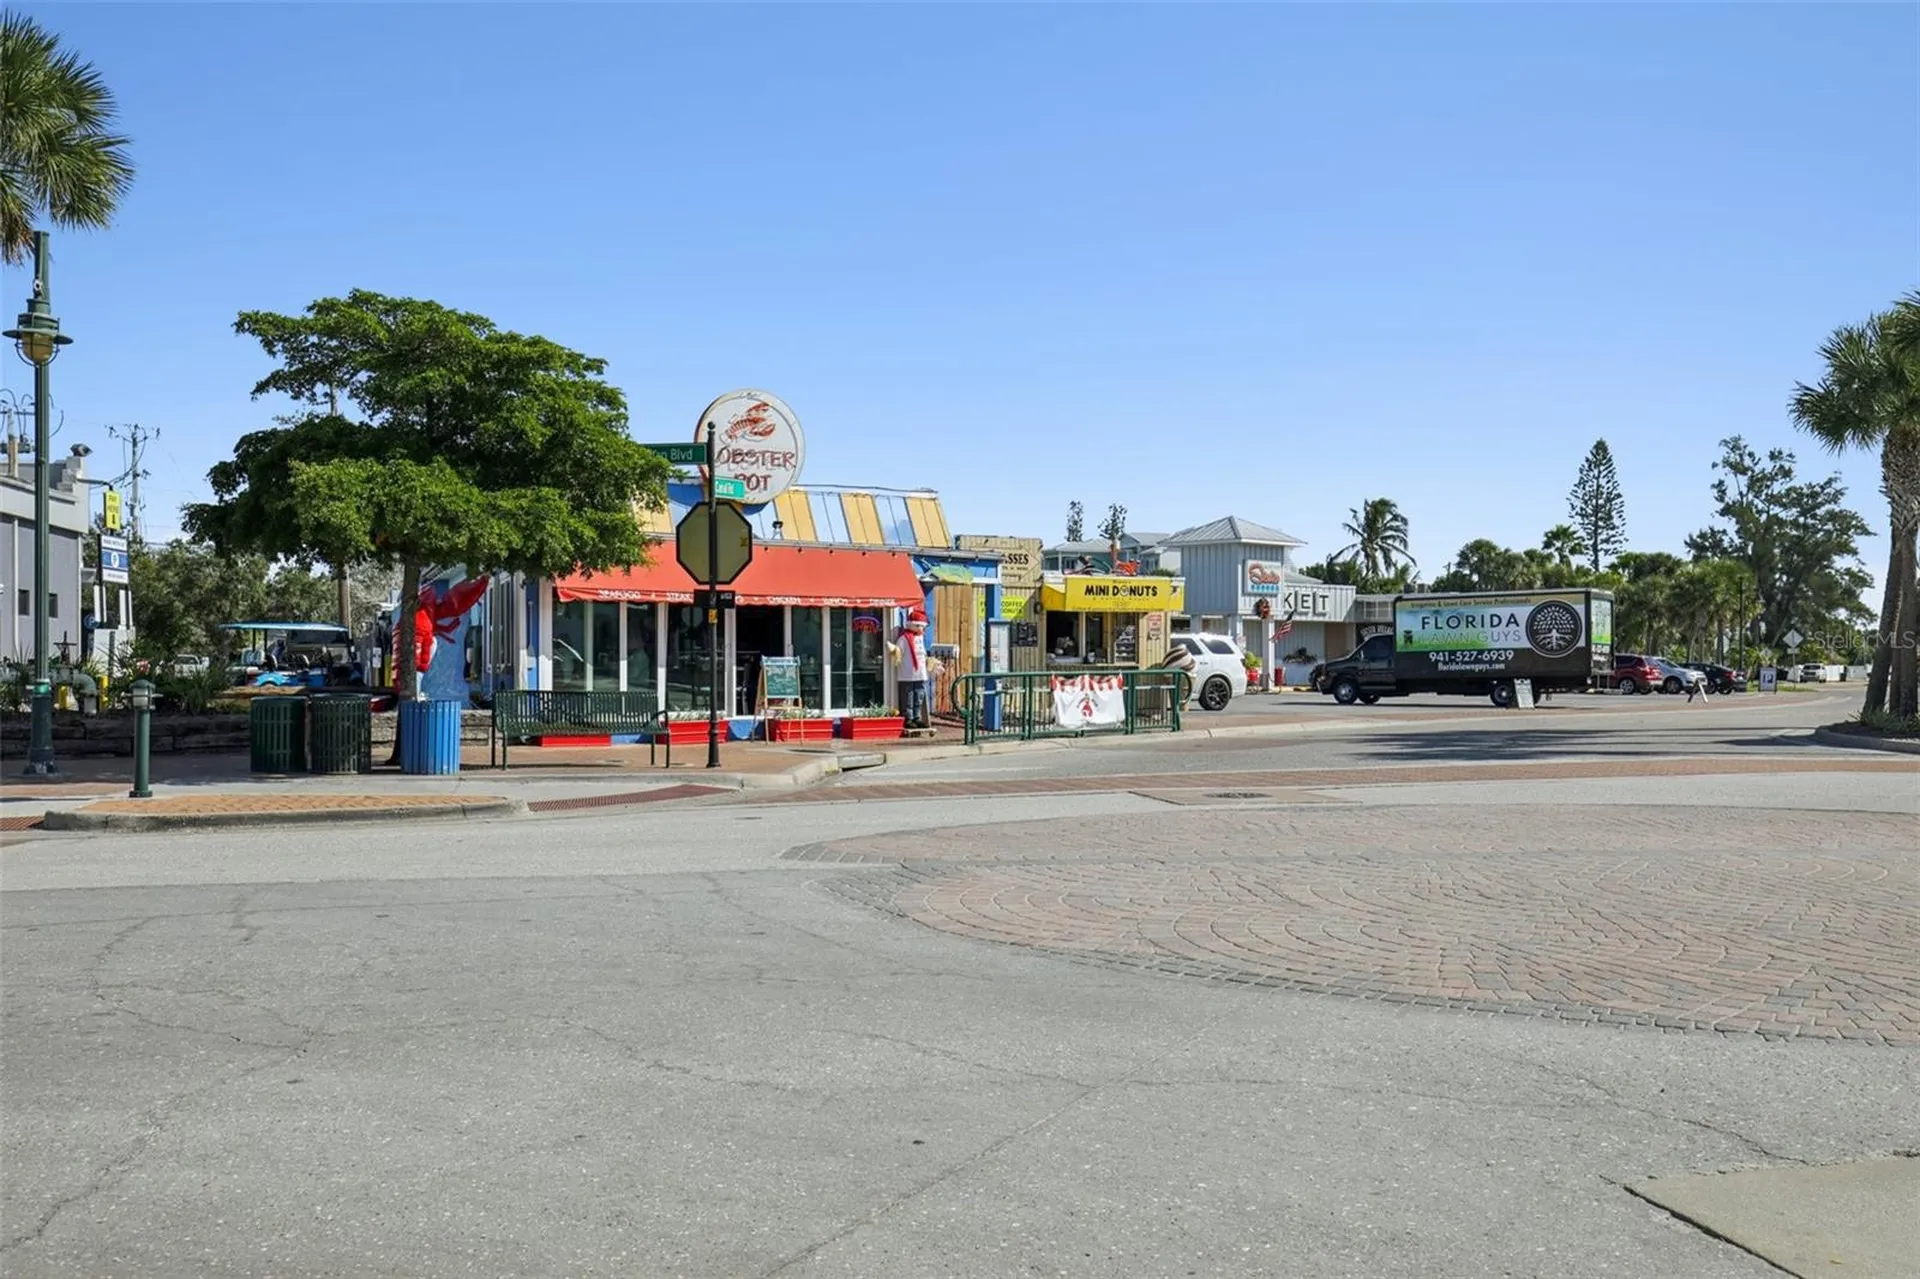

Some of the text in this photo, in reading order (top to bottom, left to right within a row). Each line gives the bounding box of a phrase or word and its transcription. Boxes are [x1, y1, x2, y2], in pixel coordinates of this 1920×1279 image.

[670, 447, 694, 461] Blvd
[1084, 584, 1158, 597] MINI DONUTS
[1421, 613, 1520, 630] FLORIDA
[1477, 630, 1521, 643] GUYS
[1429, 649, 1515, 662] 941-527-6939
